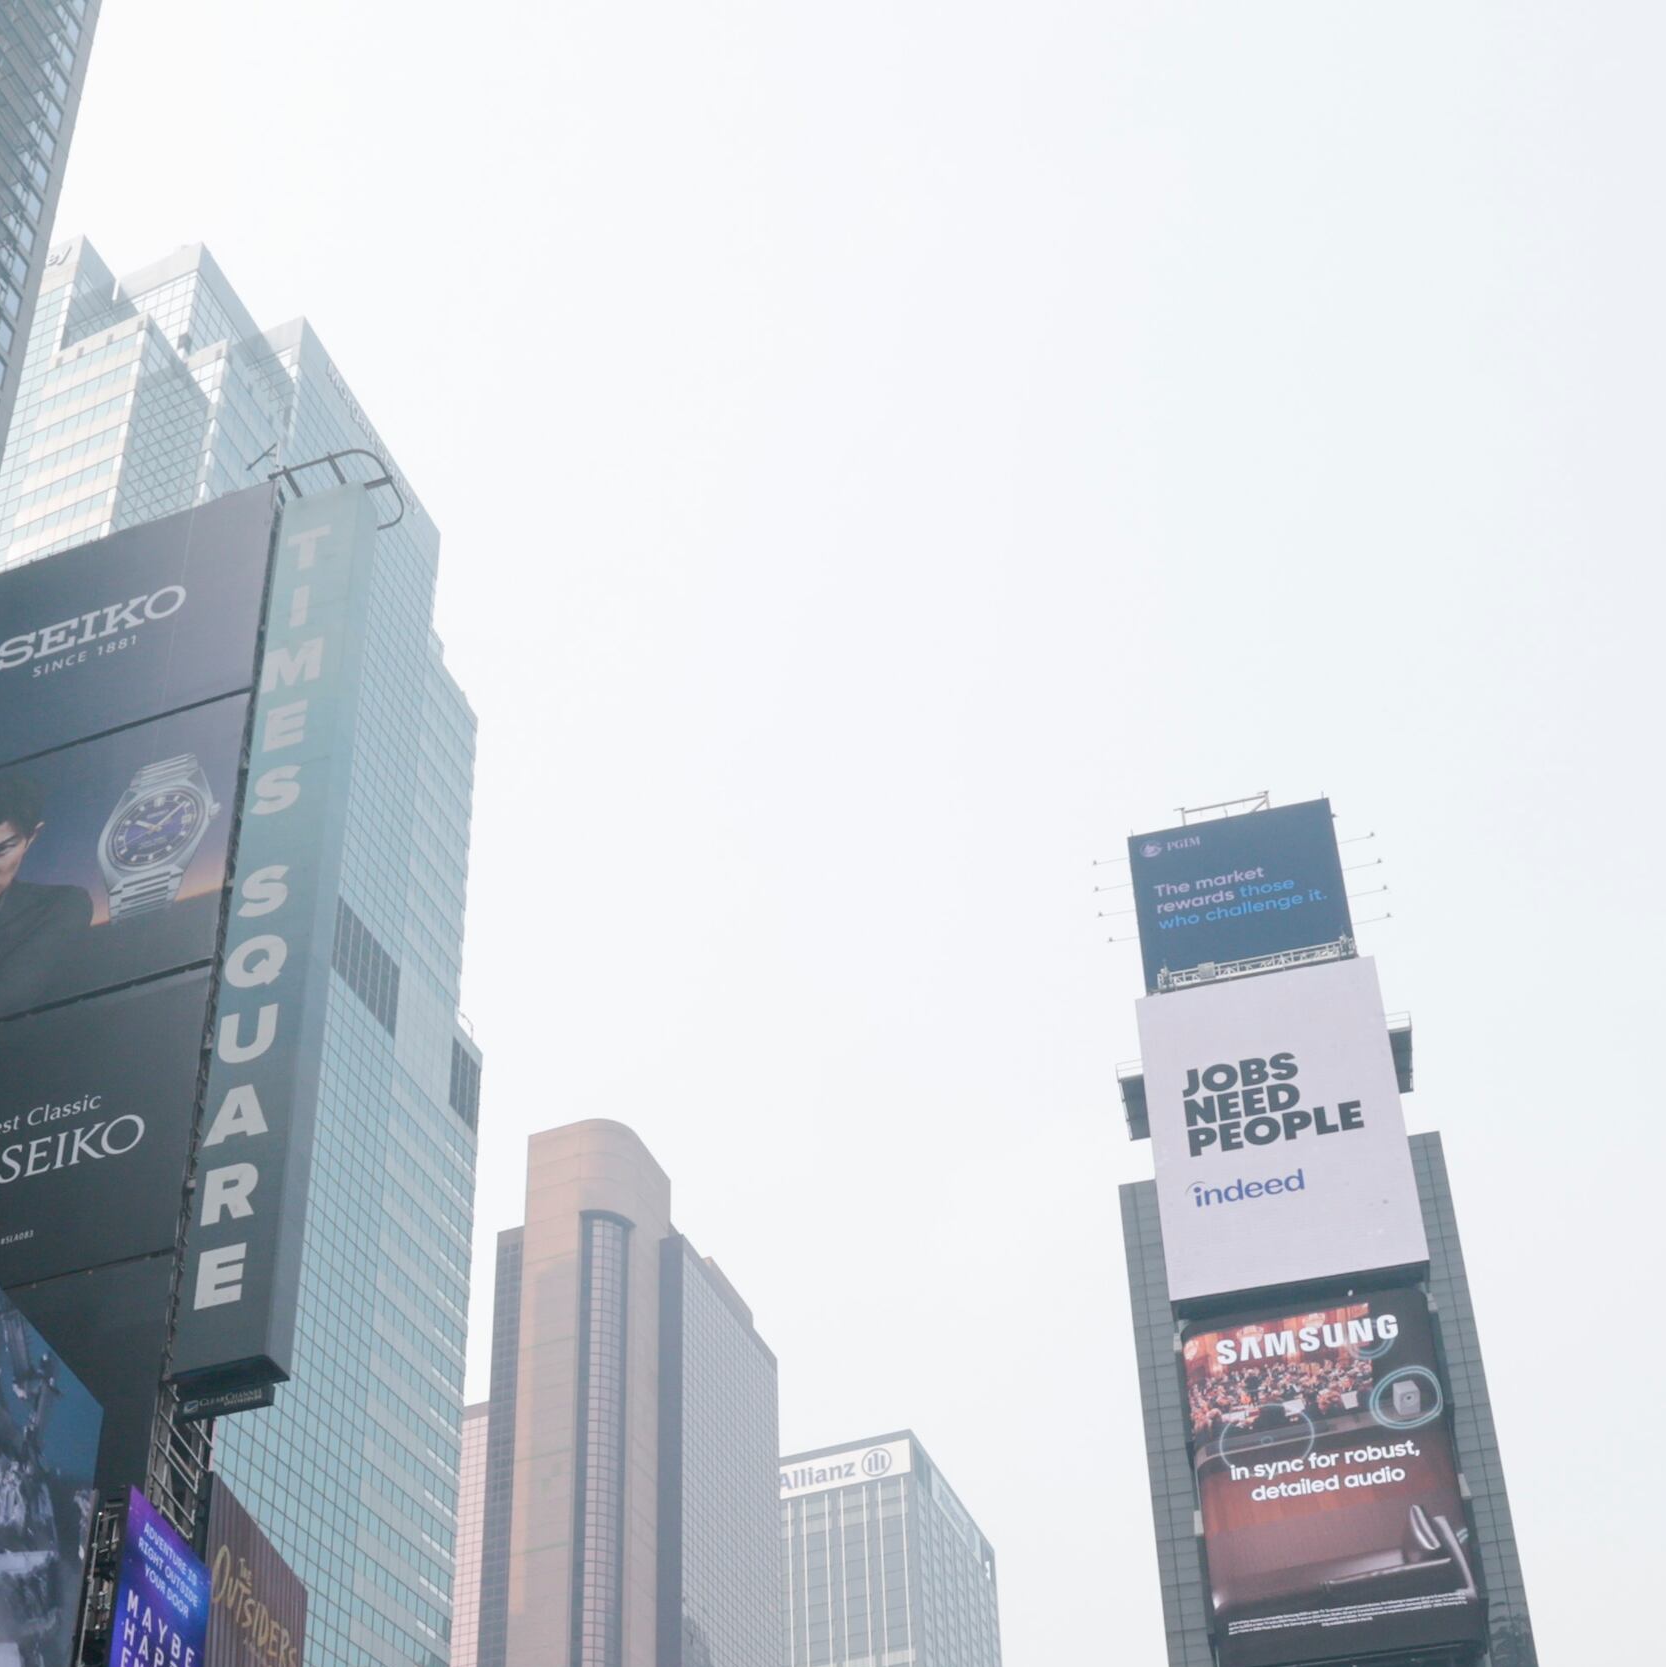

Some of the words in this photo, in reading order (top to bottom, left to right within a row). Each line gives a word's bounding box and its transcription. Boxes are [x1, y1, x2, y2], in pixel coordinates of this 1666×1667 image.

[33, 651, 87, 678] SINCE
[96, 634, 138, 658] 1881
[250, 525, 332, 817] TIMES
[1167, 836, 1201, 852] PGIM
[1154, 879, 1191, 897] The
[1195, 866, 1264, 891] market
[1156, 888, 1235, 915] rewards
[1239, 877, 1295, 899] those
[1159, 912, 1200, 930] who
[1205, 894, 1303, 923] challenge
[1309, 888, 1328, 906] it.
[192, 864, 289, 1312] SQUARE
[1182, 1052, 1299, 1098] JOBS
[26, 1093, 102, 1127] Classic
[1184, 1082, 1300, 1128] NEED
[1187, 1099, 1365, 1158] PEOPLE
[1194, 1168, 1305, 1208] indeed
[1215, 1313, 1399, 1365] SAMSUNG
[780, 1461, 855, 1491] Allianz
[1230, 1464, 1250, 1481] in
[1253, 1459, 1305, 1480] sync
[1308, 1451, 1339, 1469] for
[1345, 1439, 1420, 1465] robust,
[1251, 1474, 1340, 1503] detailed
[1344, 1466, 1406, 1489] audio
[144, 1522, 193, 1576] ADVENTURE
[138, 1536, 164, 1573] RIGHT
[164, 1564, 199, 1608] OUTSIDE
[144, 1564, 166, 1594] YOUR
[166, 1588, 189, 1619] DOOR
